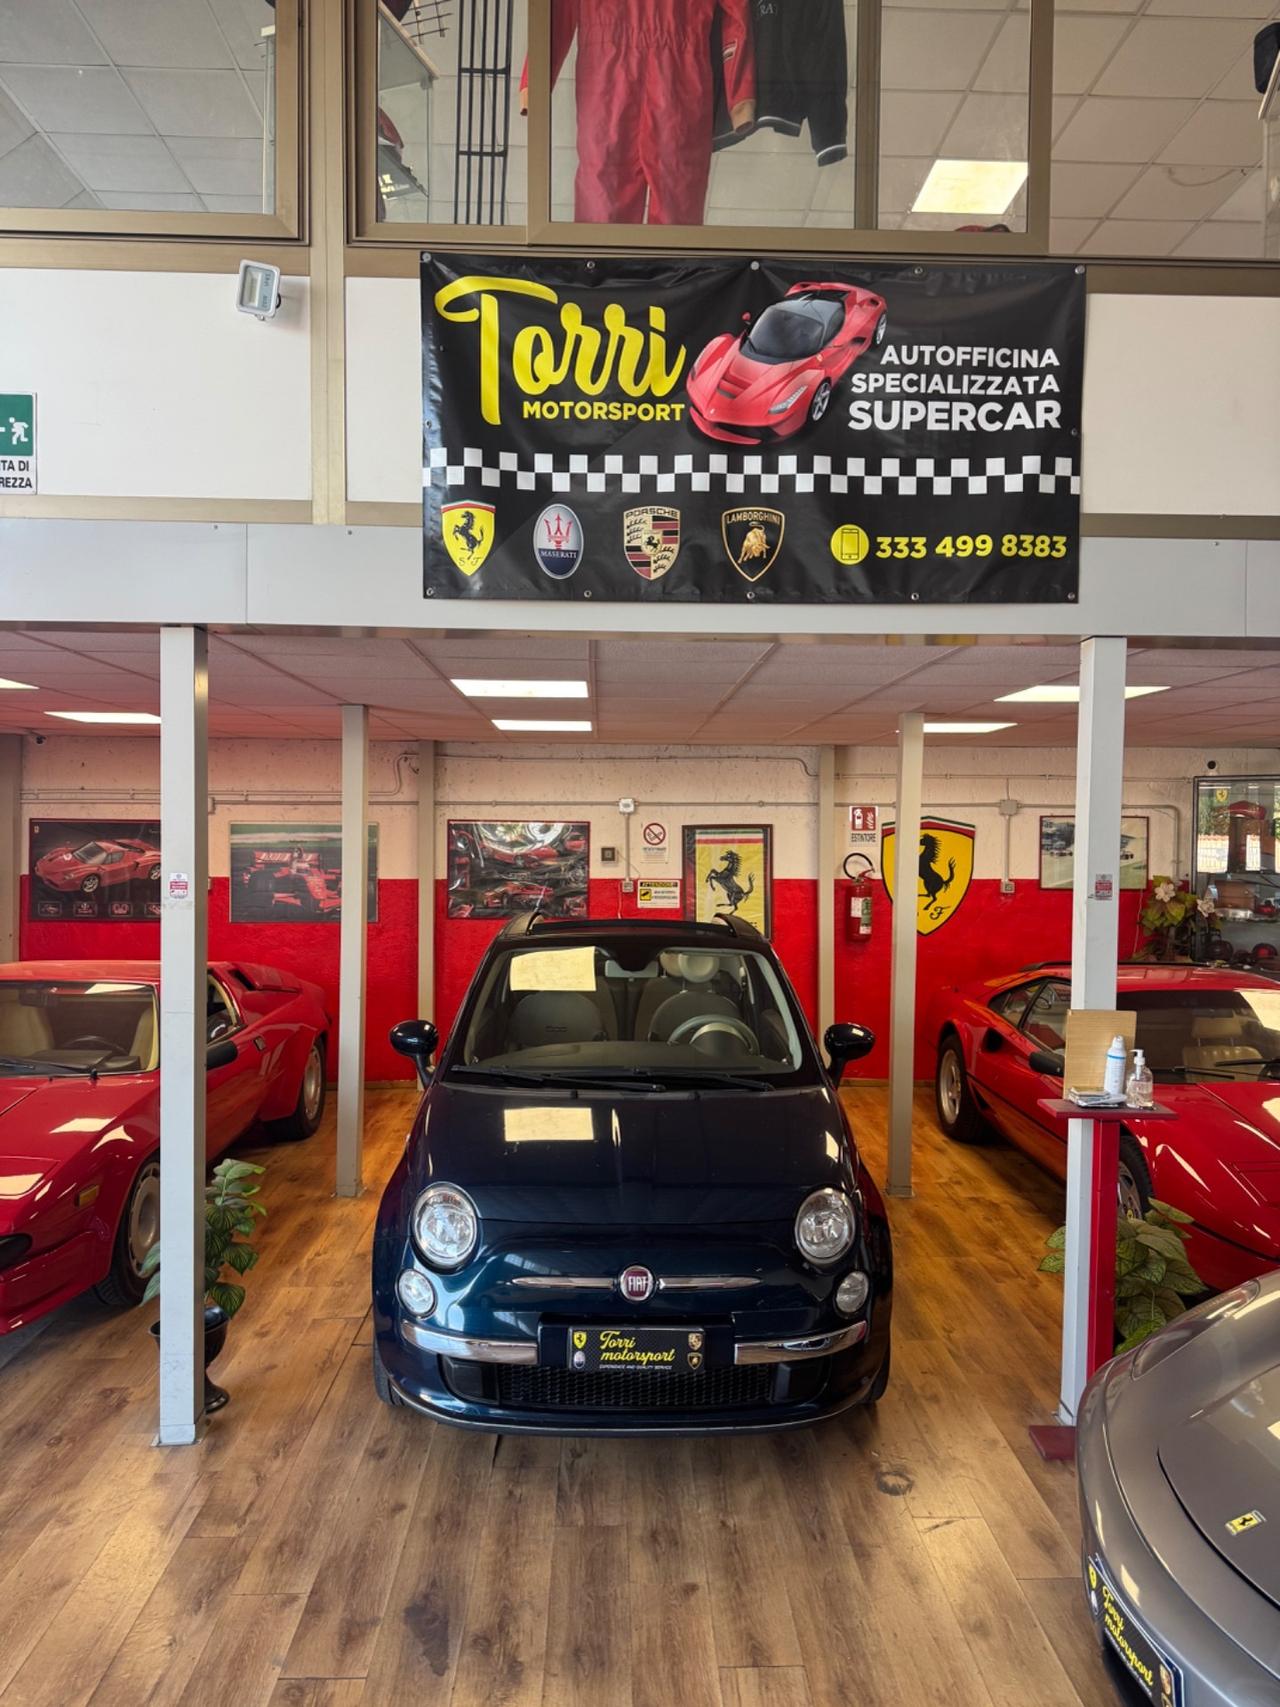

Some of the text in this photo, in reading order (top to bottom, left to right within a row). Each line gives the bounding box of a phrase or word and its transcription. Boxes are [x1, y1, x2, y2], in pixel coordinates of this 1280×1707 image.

[435, 275, 687, 425] Torri
[880, 344, 1060, 369] AUTOFFICINA
[850, 372, 1060, 396] SPECIALIZZATA
[522, 400, 685, 422] MOTORSPORT
[847, 399, 1062, 432] SUPERCAR
[18, 459, 29, 471] DI
[625, 507, 679, 519] PORSCHE
[727, 511, 781, 525] LAMBORGHINI
[540, 549, 577, 559] MASERATI
[875, 534, 1067, 559] 333 499 8383
[628, 1276, 649, 1292] FIAT
[600, 1330, 636, 1350] Torri
[600, 1348, 675, 1366] motorsport
